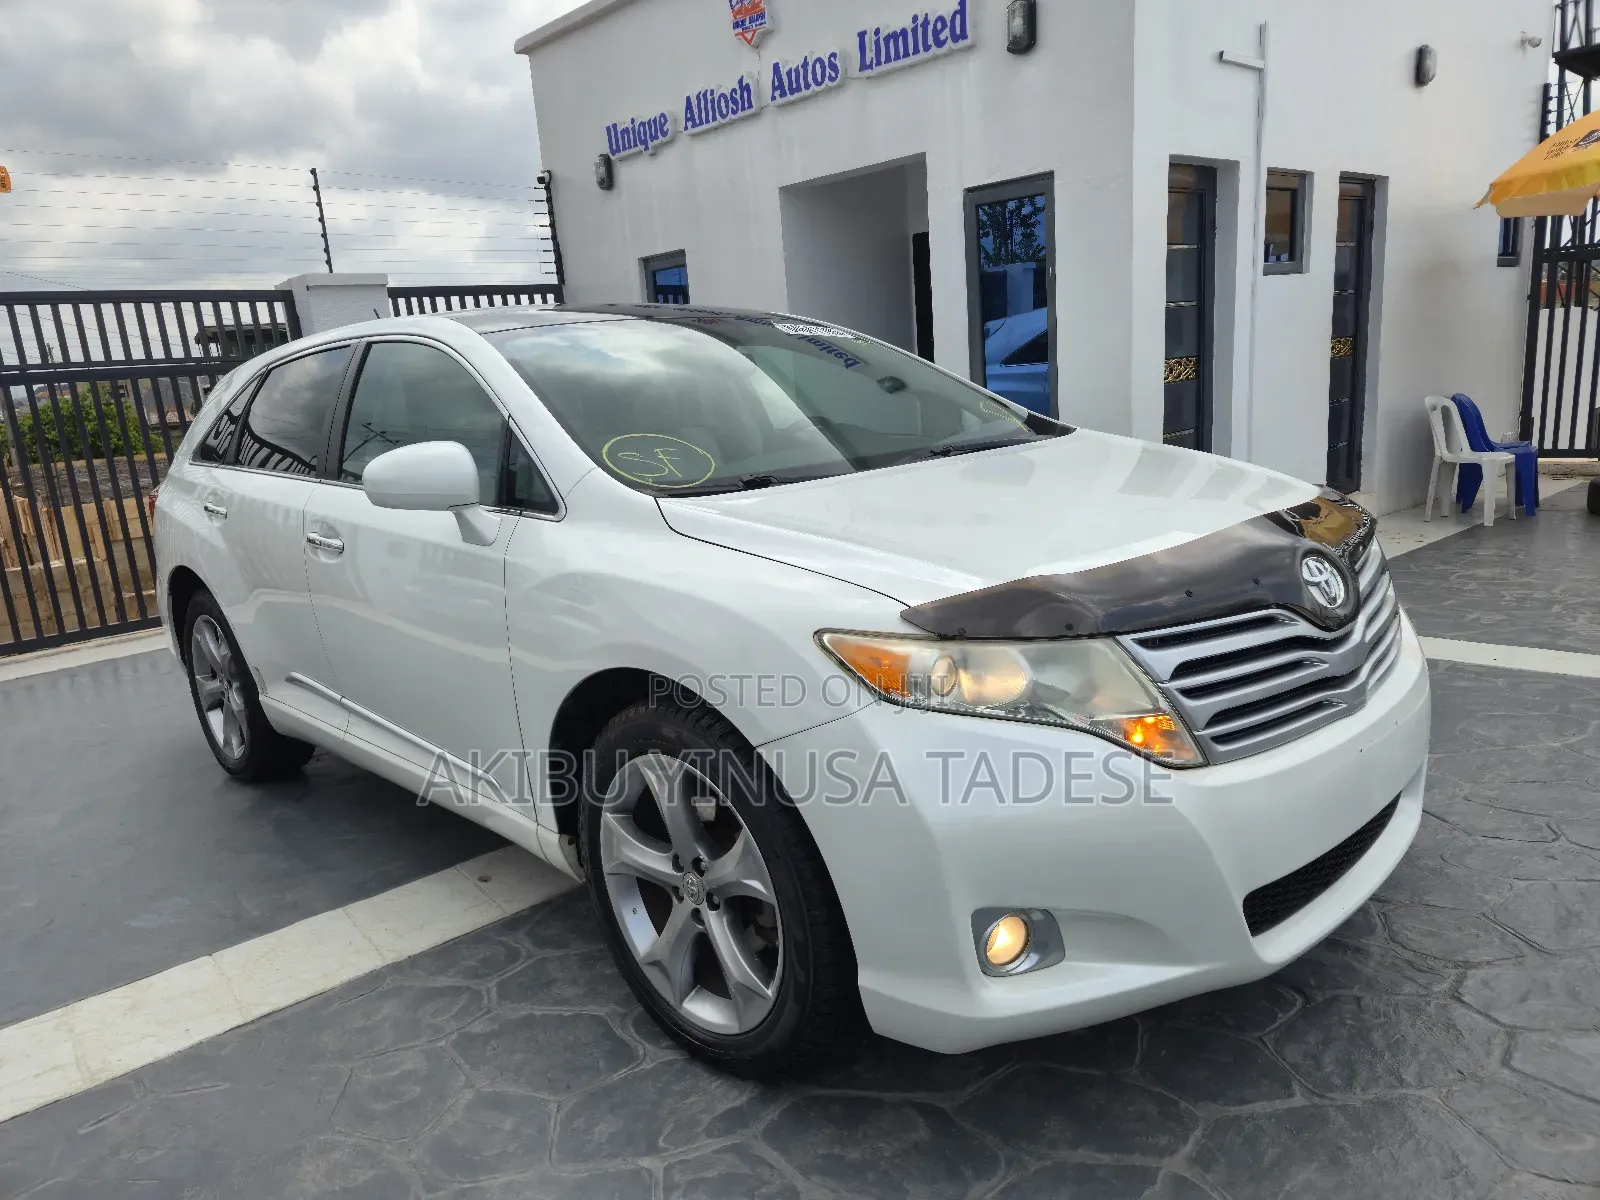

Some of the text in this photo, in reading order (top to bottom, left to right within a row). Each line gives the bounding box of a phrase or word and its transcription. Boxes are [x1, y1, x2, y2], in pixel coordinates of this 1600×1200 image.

[605, 0, 968, 156] Unique Alliosh Autos Limited
